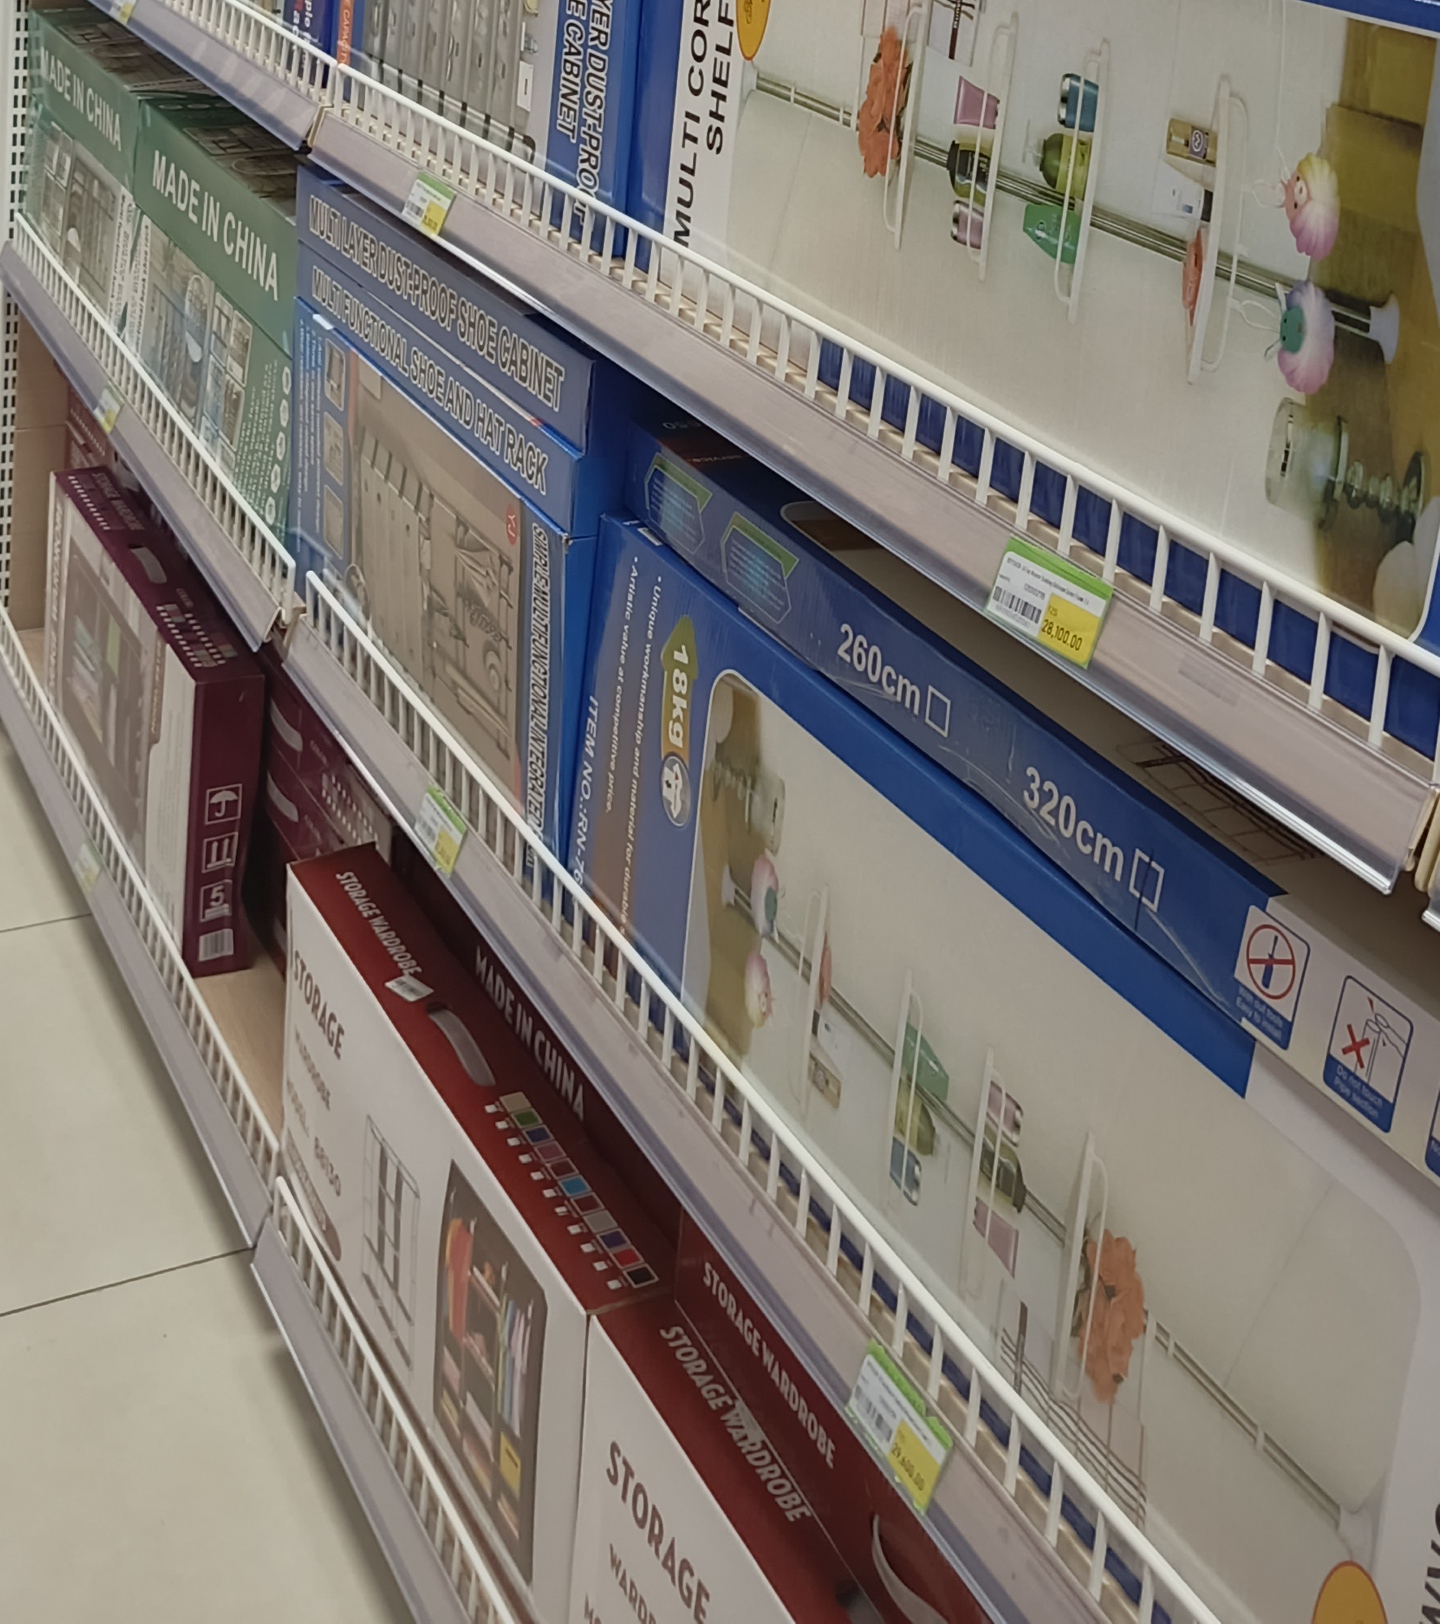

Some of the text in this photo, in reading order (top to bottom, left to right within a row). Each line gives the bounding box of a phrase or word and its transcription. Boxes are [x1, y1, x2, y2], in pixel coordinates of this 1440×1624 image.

[40, 45, 121, 152] MADE IN CHINA
[555, 19, 587, 142] CABINET
[152, 149, 200, 224] MADE
[202, 191, 221, 242] IN
[223, 211, 278, 301] CHINA
[673, 110, 701, 248] MULTI
[309, 194, 565, 413] MULTI LAYER DUST-PROOF SHOE CABINET
[312, 265, 549, 496] MULTI FUNCTIONAL SHOE AND HAT RACK
[604, 564, 639, 814] Artistic value at competitive price.
[668, 643, 690, 749] 18kg
[836, 624, 920, 715] 260cm
[1041, 619, 1083, 651] 28,100.00
[584, 696, 600, 758] ITEM
[619, 585, 661, 923] Unique workmanship and material for durable
[1023, 767, 1125, 882] 320cm
[336, 870, 423, 977] STORAGE WARDROBE
[294, 949, 345, 1060] STORAGE
[475, 945, 584, 1122] MADE IN CHINA
[660, 1325, 811, 1523] STORAGE WARDROBE
[702, 1261, 837, 1470] STORAGE WARDROBE
[606, 1440, 711, 1624] STORAGE
